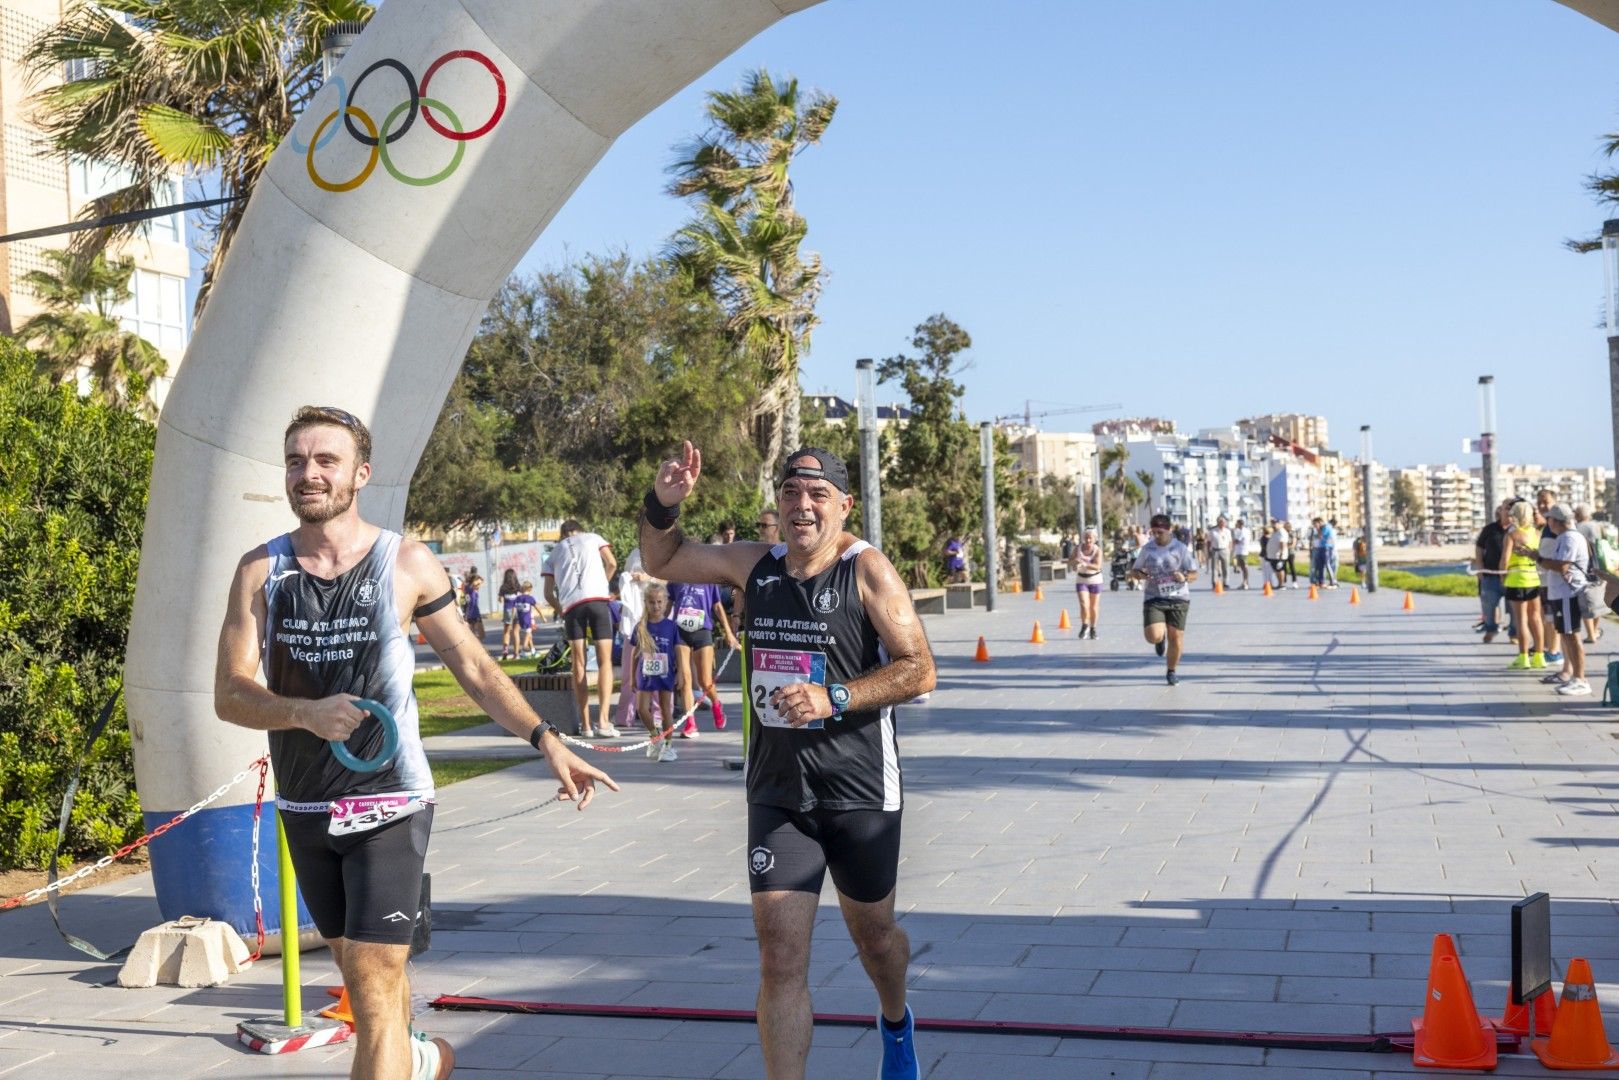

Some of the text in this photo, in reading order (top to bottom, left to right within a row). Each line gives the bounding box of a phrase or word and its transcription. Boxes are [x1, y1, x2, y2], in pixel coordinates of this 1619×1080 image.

[282, 618, 309, 631] CLUB
[681, 619, 694, 628] 40
[753, 617, 828, 632] CLUB ATLETISMO
[778, 631, 837, 645] TORREVIEJA
